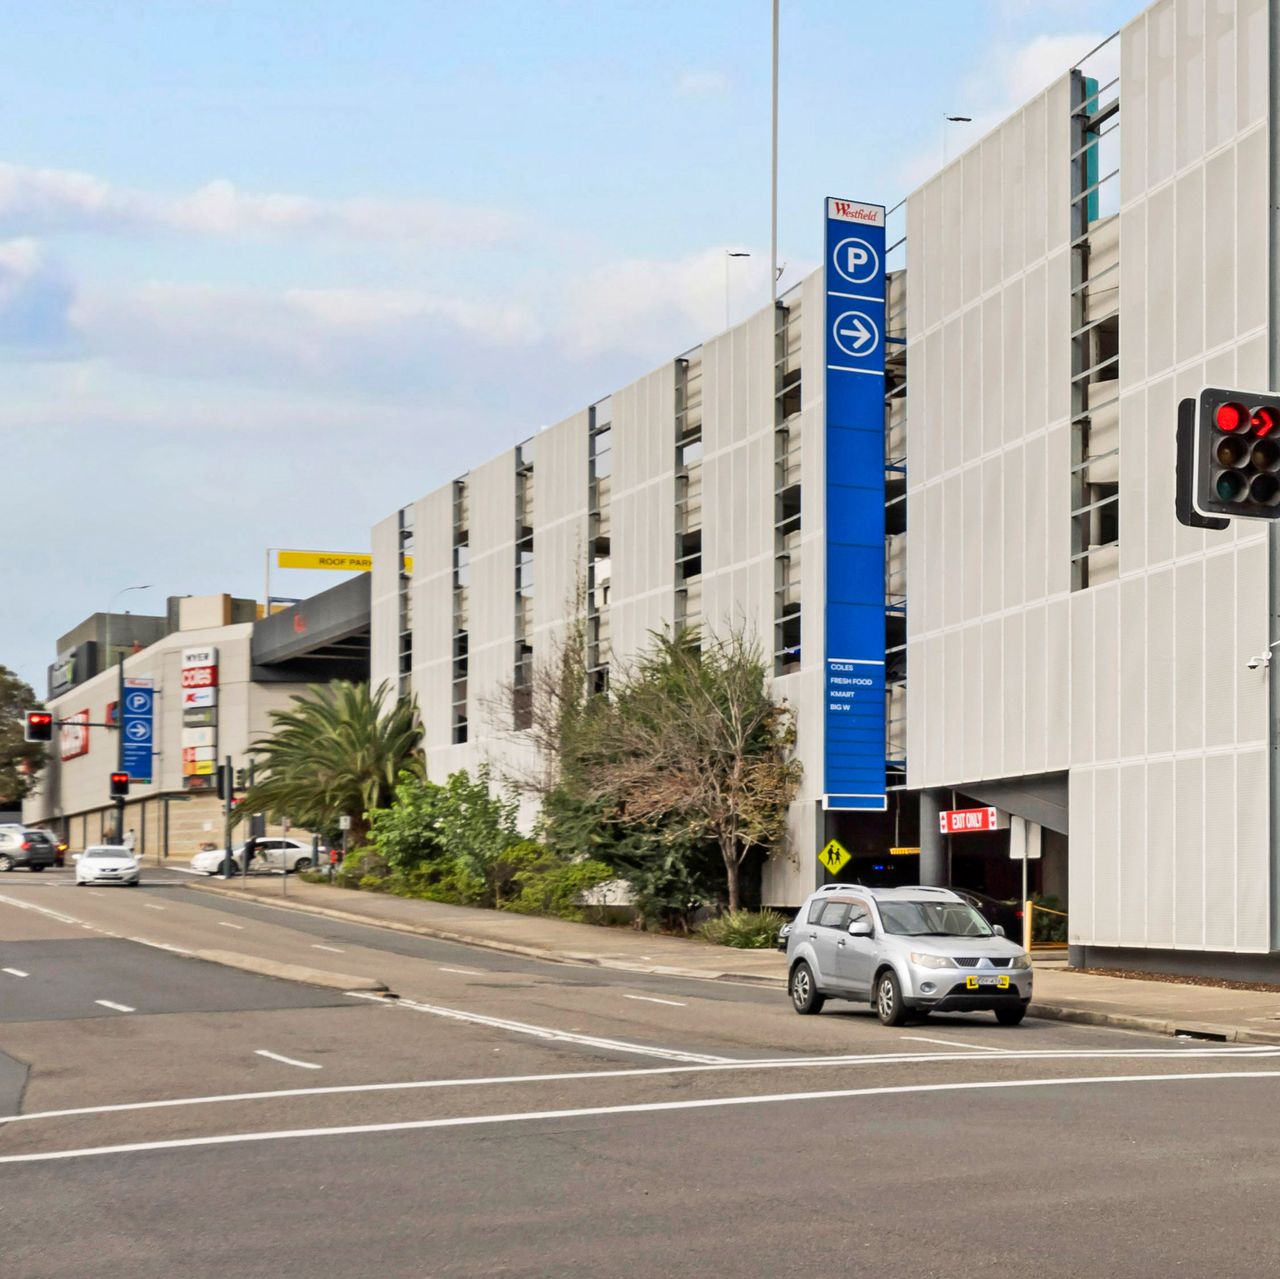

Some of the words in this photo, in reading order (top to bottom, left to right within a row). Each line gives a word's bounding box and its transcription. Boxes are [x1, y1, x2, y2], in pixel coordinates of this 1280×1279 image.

[834, 202, 878, 221] Westfield
[847, 246, 868, 273] P
[319, 557, 345, 565] ROOF
[133, 696, 145, 708] P
[952, 813, 966, 829] EXIT
[966, 811, 982, 828] ONLY
